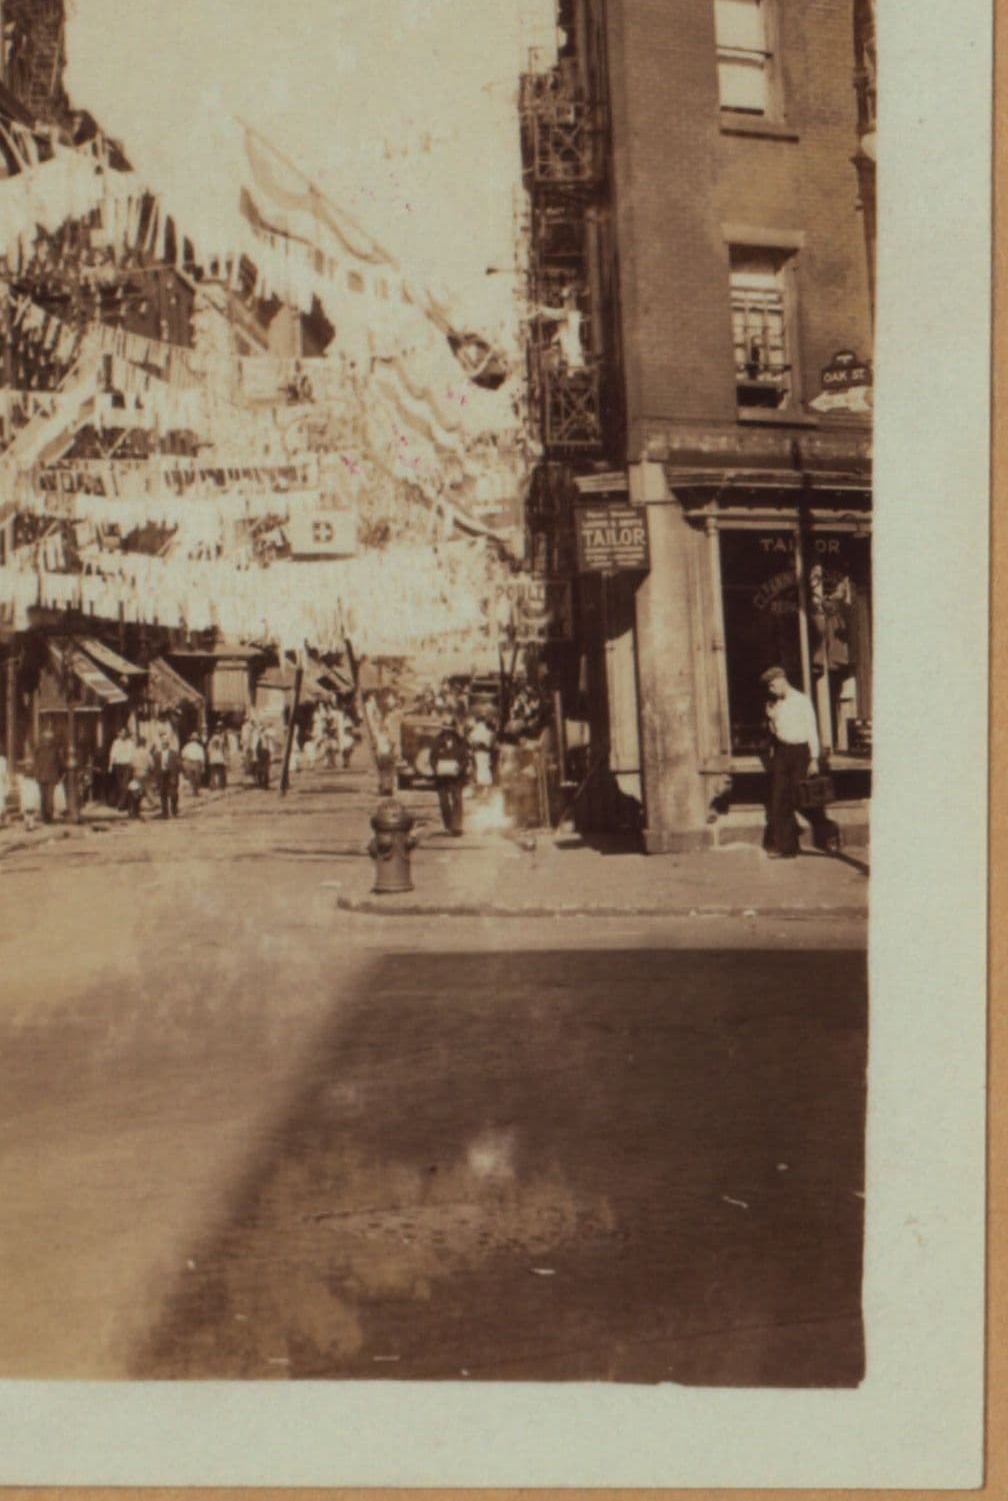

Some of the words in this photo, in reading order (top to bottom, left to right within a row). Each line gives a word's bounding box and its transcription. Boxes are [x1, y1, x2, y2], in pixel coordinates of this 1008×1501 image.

[823, 370, 848, 383] OAK
[581, 528, 647, 548] TAILOR
[759, 538, 841, 554] TAIOR
